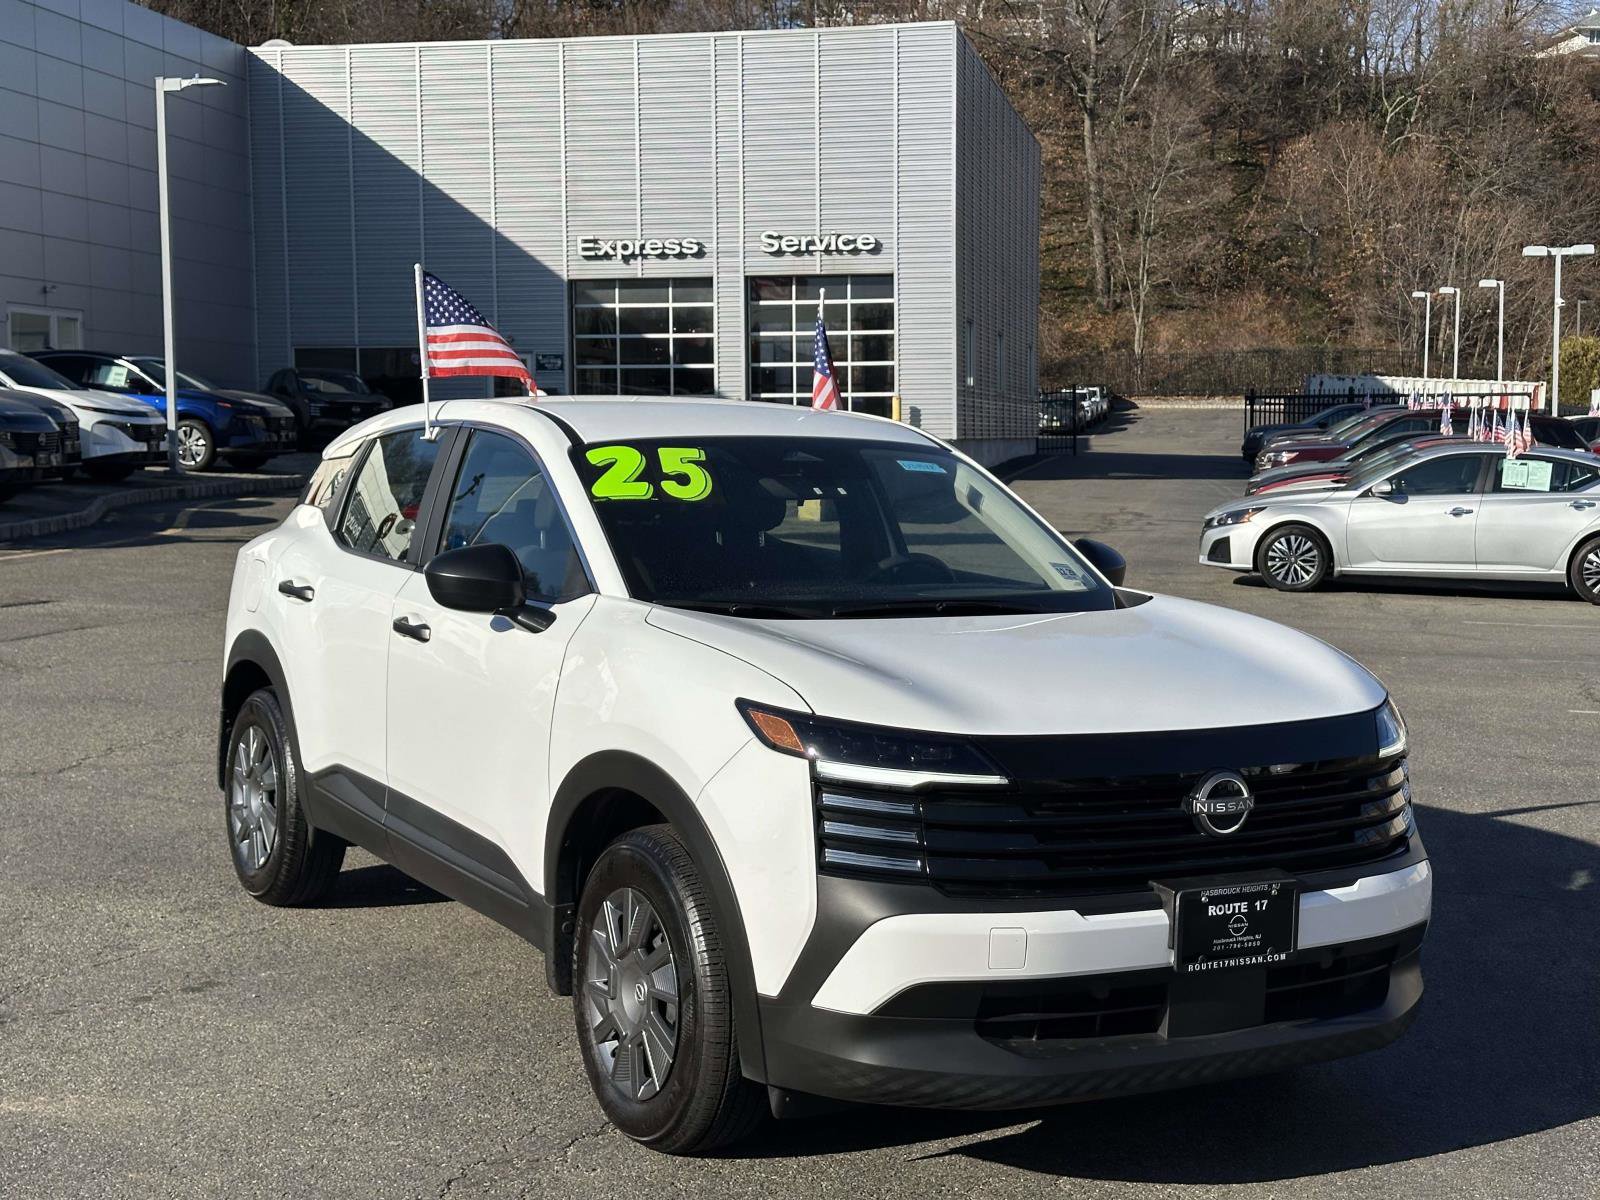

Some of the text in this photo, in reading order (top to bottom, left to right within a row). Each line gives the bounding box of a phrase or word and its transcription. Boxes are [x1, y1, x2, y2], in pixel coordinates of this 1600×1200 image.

[576, 230, 877, 259] Express Service
[585, 446, 713, 501] 25
[1196, 798, 1254, 813] NISSAN
[1201, 887, 1241, 897] HASBROUCK
[1208, 900, 1268, 916] ROUTE 17
[1188, 953, 1286, 972] ROUTE17NISSAN.COM
